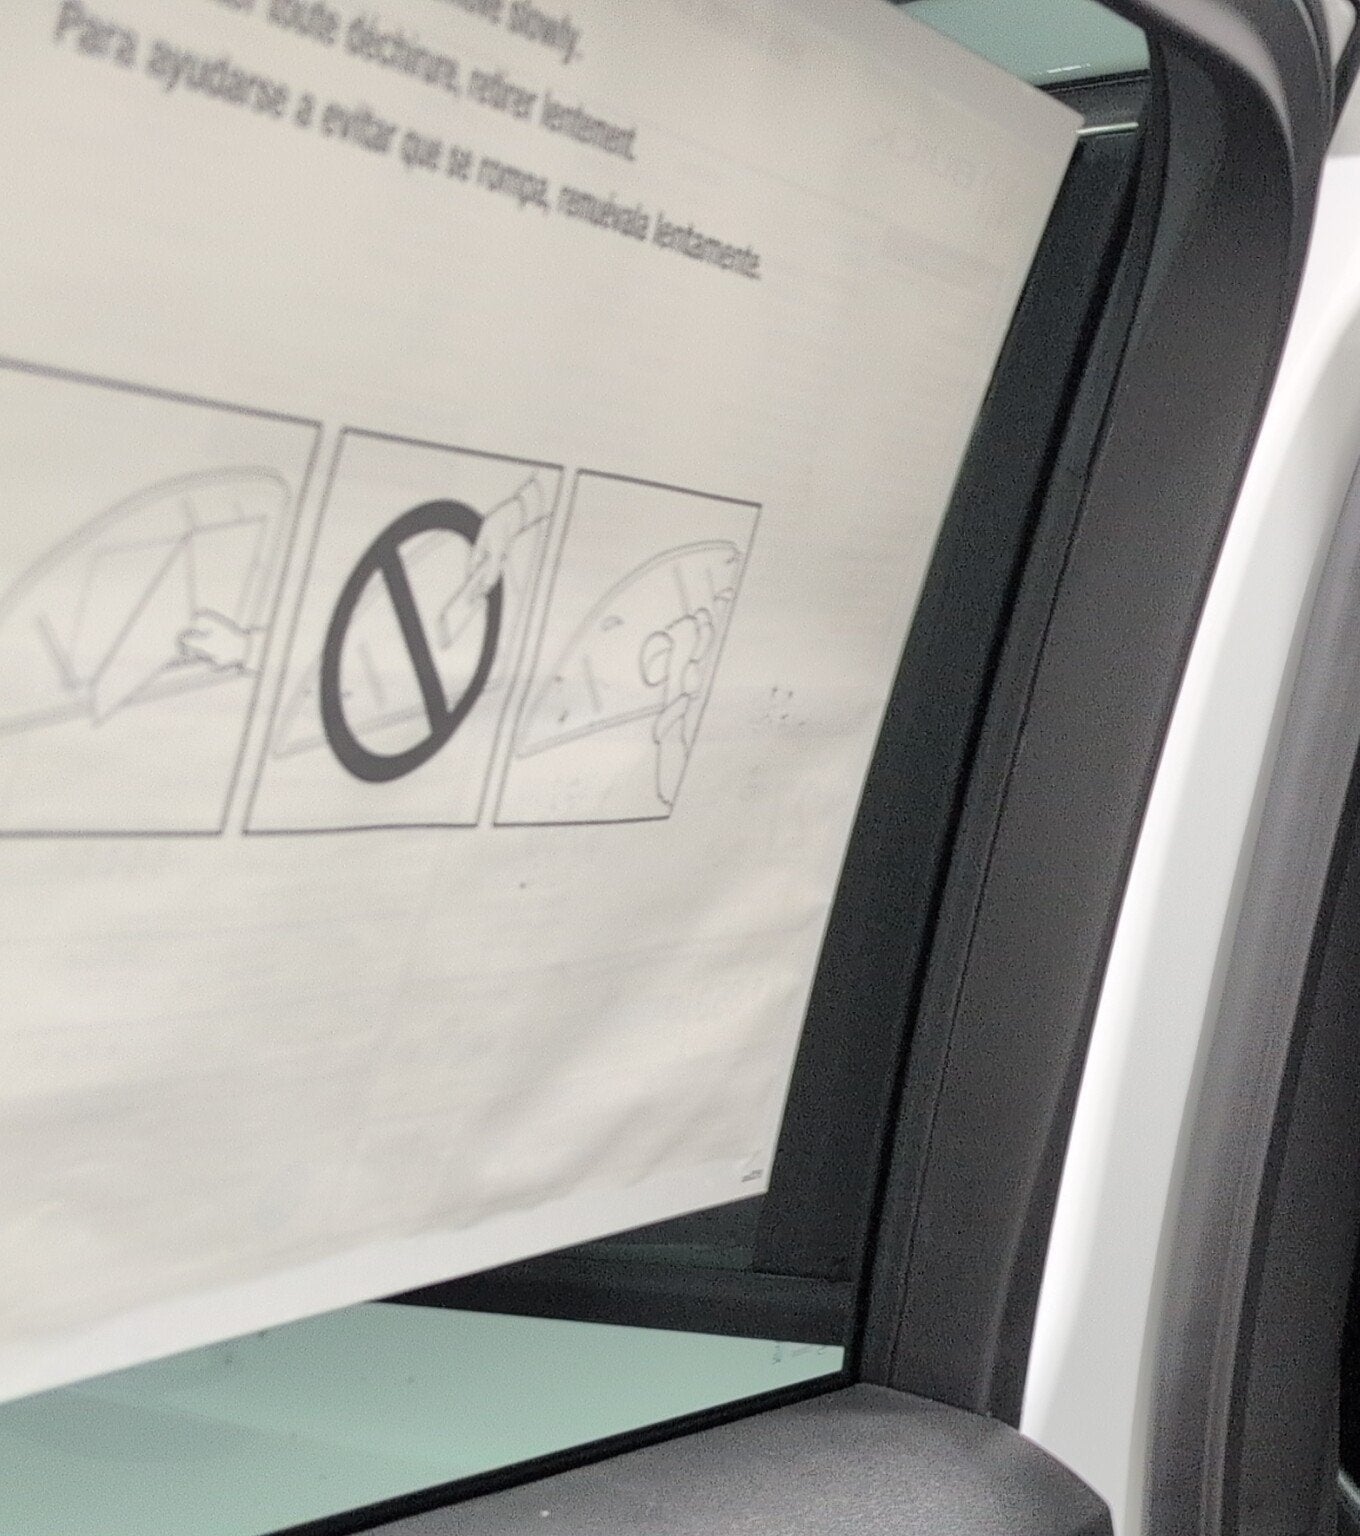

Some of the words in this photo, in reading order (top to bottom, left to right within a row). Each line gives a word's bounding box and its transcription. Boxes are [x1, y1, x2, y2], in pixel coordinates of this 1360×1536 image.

[54, 0, 137, 68] Para
[147, 38, 288, 118] ayudarse
[296, 92, 315, 127] a
